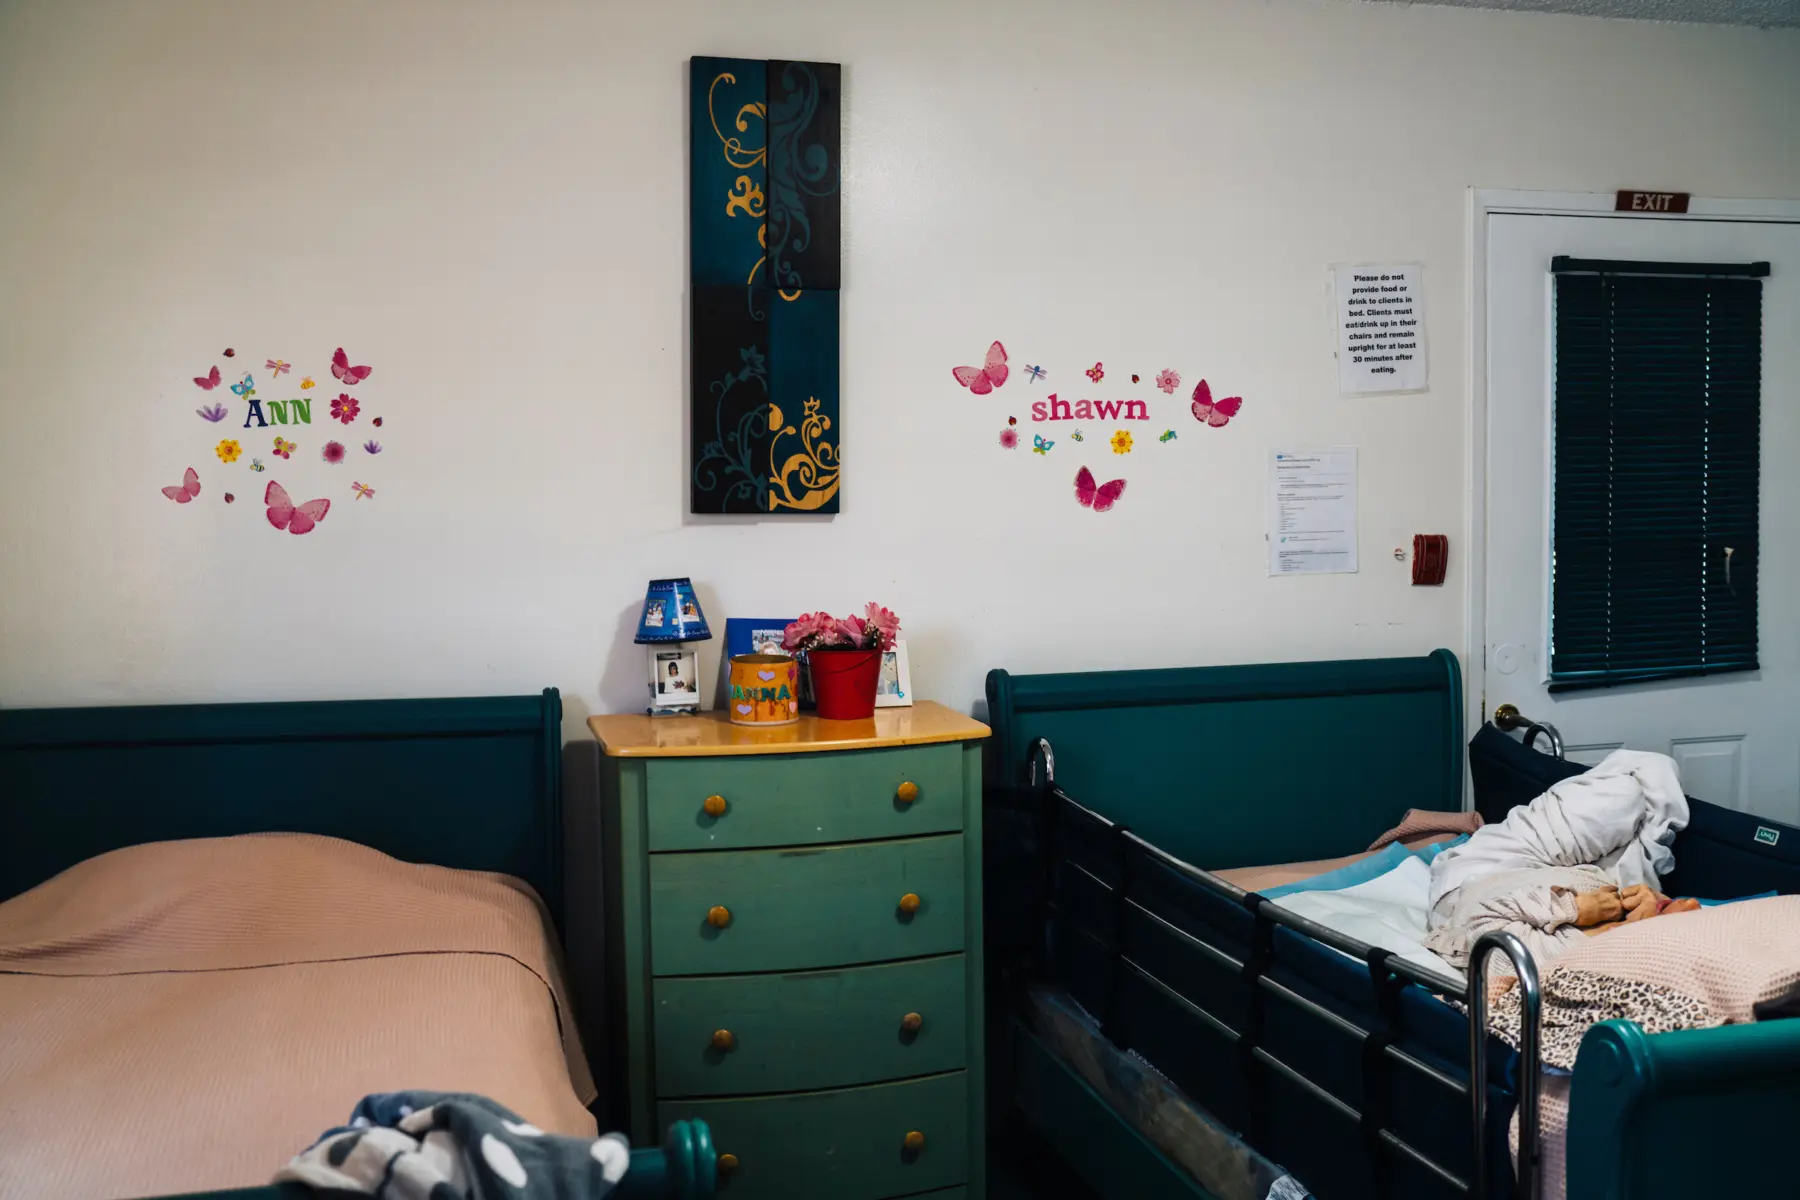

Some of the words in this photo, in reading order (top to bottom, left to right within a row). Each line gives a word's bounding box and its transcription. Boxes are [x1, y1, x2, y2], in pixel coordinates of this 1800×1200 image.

[1632, 193, 1674, 211] EXIT
[1352, 286, 1379, 295] provide
[1348, 344, 1375, 352] upright
[243, 398, 312, 428] ANN
[1031, 393, 1150, 422] shawn
